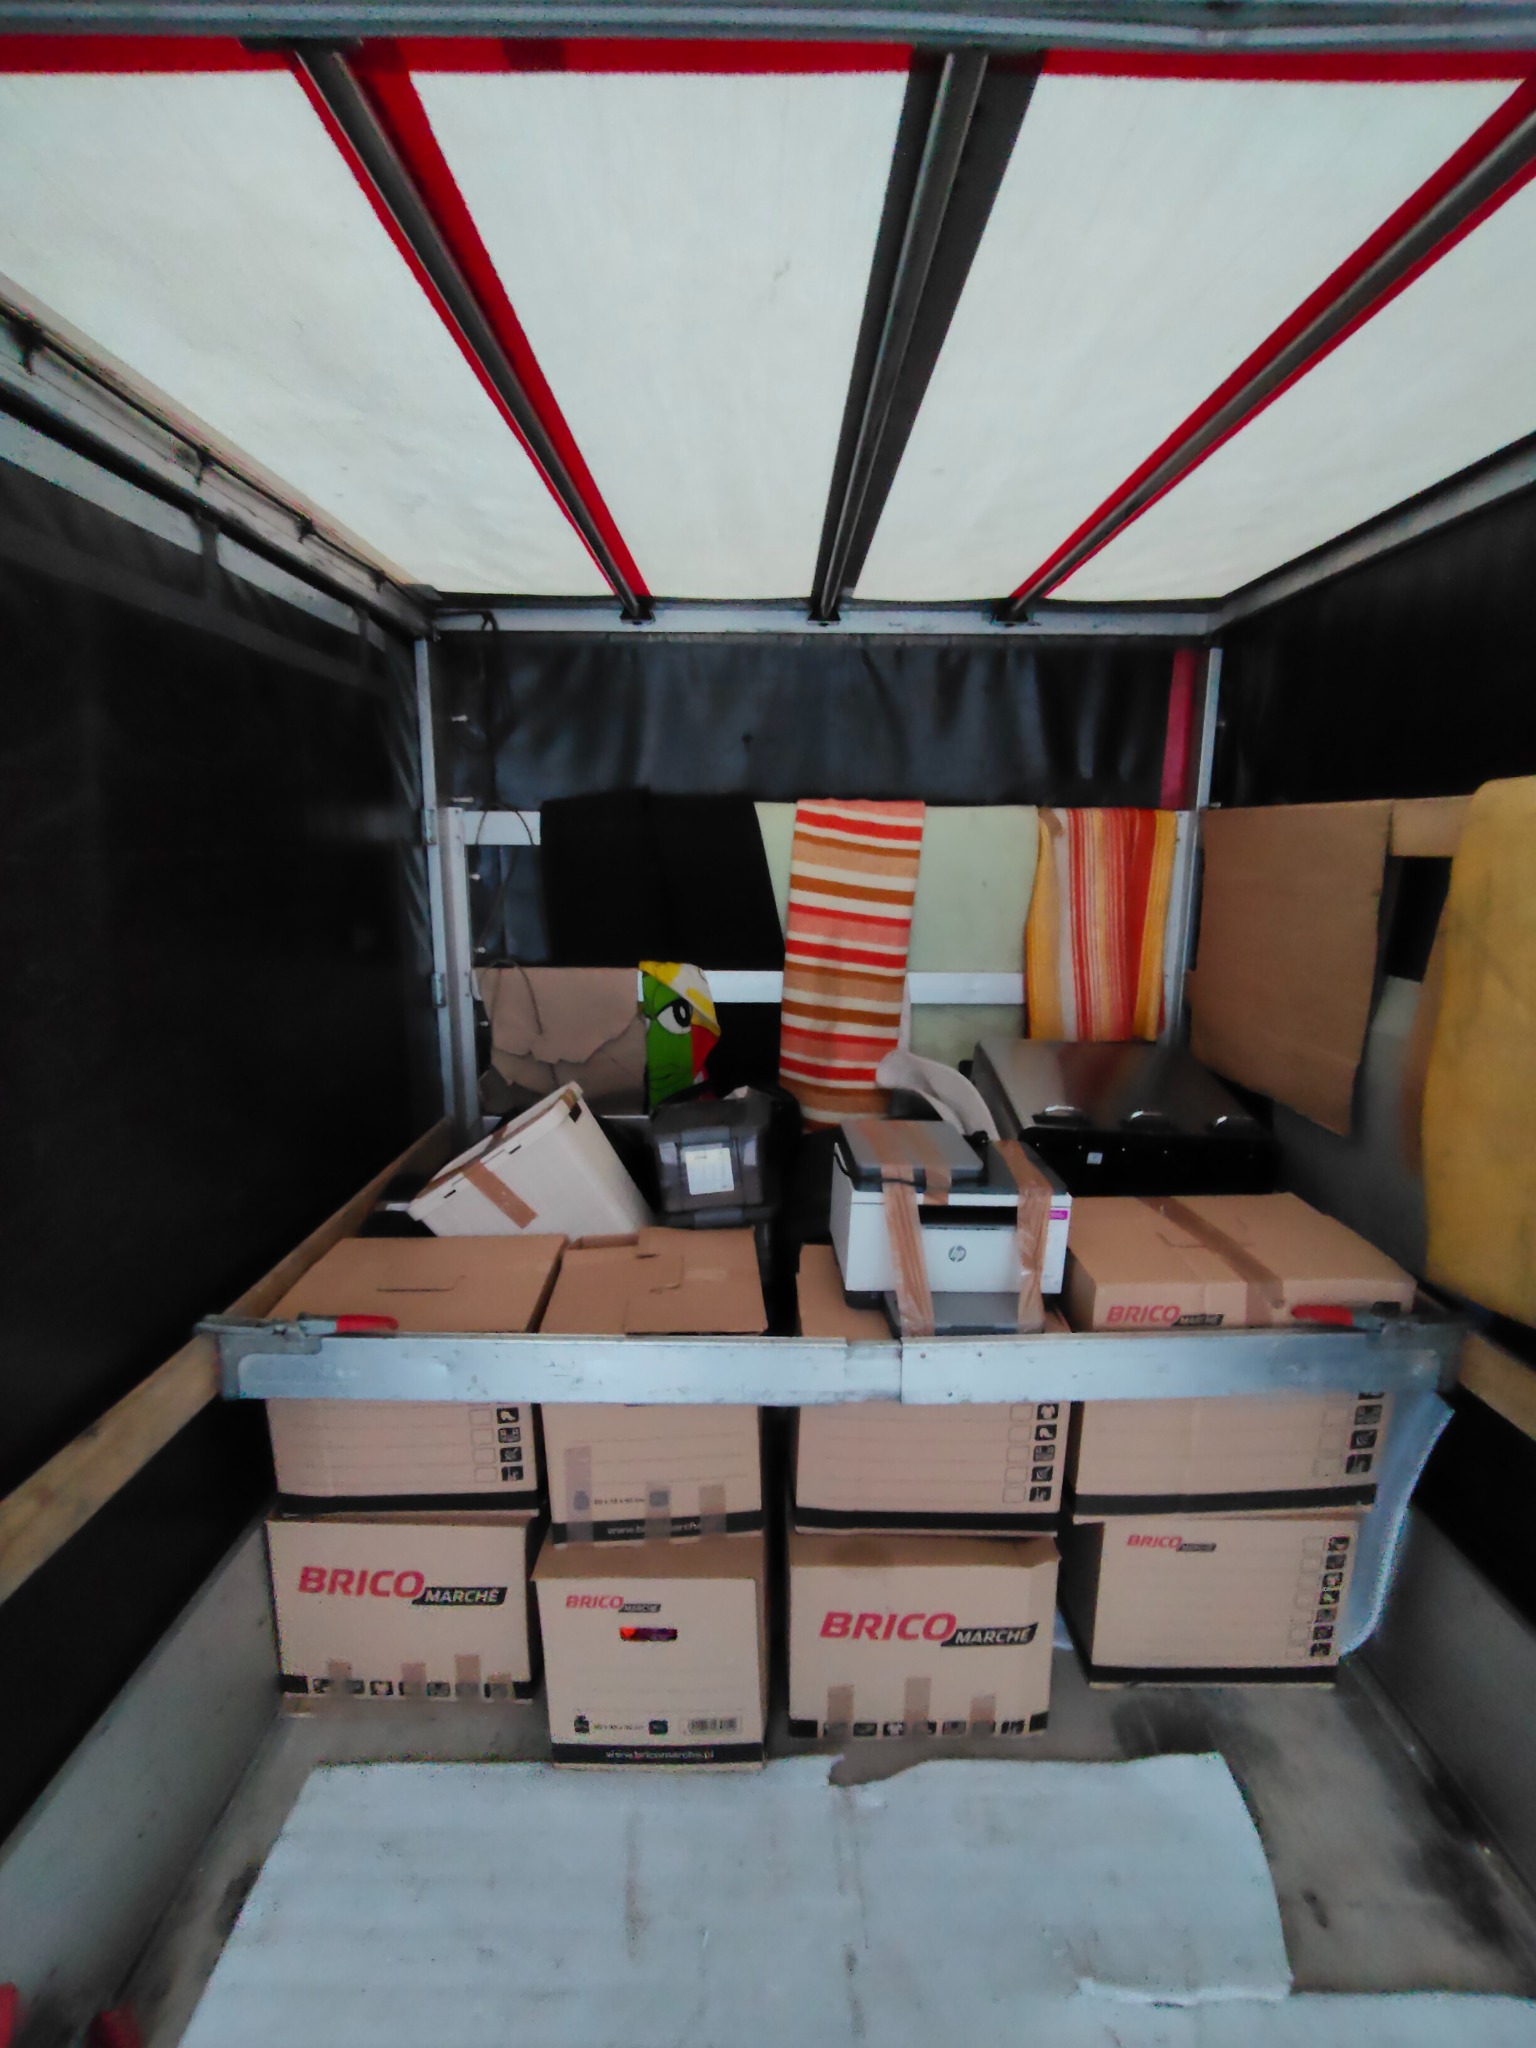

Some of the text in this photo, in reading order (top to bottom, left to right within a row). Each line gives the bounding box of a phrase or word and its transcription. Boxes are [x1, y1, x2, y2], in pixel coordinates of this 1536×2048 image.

[1106, 1304, 1181, 1324] BRICO
[1127, 1534, 1183, 1549] BRICO
[298, 1566, 425, 1599] BRICO
[566, 1594, 624, 1609] BRICO
[819, 1611, 957, 1641] BRICO
